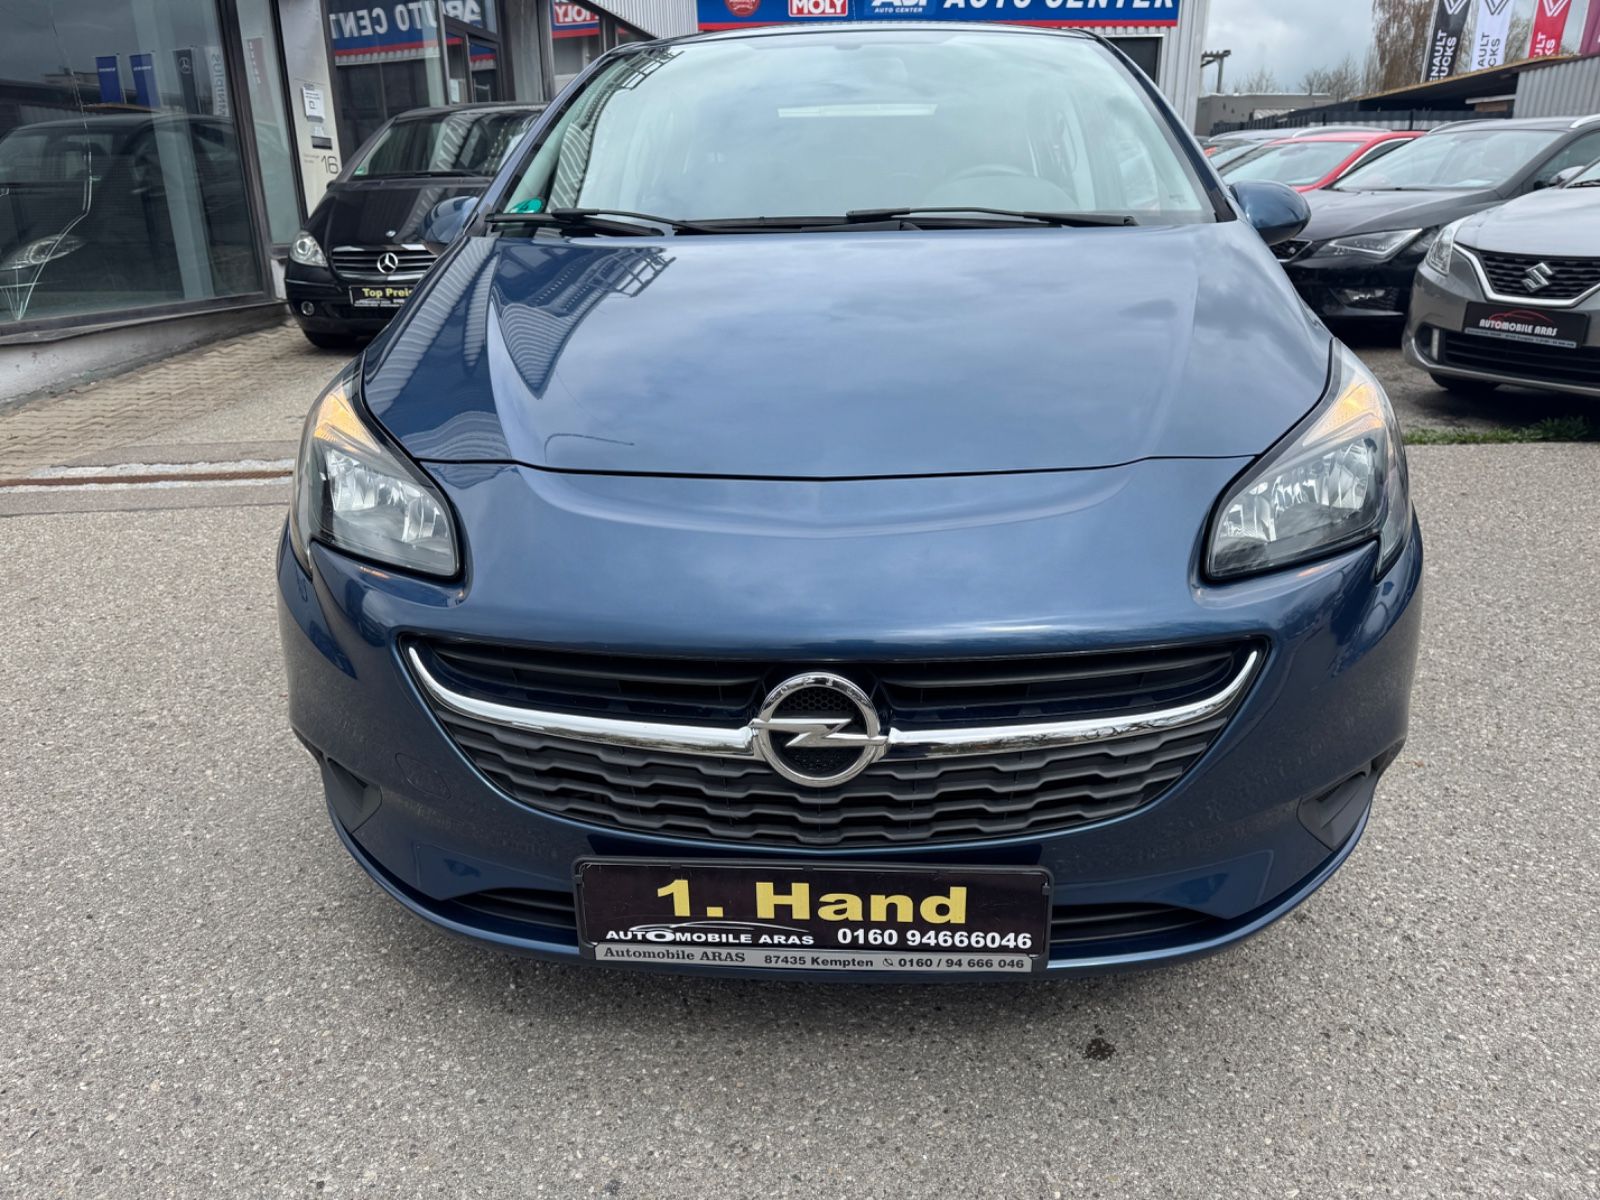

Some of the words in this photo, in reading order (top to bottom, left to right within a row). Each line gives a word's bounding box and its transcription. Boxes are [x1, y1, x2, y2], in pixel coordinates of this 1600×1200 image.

[792, 0, 843, 14] MOLY
[321, 155, 338, 175] 16
[361, 288, 383, 298] Top
[1479, 319, 1533, 333] AUTOMOBILE
[1534, 327, 1558, 336] ARAS
[756, 882, 967, 924] Hand
[606, 928, 752, 944] AUTOMOBILE
[758, 934, 815, 945] ARAS
[837, 928, 898, 945] 0160
[906, 930, 1032, 949] 94666046
[603, 947, 695, 961] Automobile
[700, 951, 746, 963] ARAS
[764, 955, 806, 966] 87435
[811, 956, 874, 969] Kempten
[898, 959, 933, 969] 0160
[946, 959, 963, 969] 94
[967, 960, 993, 970] 666
[998, 960, 1024, 970] 046
